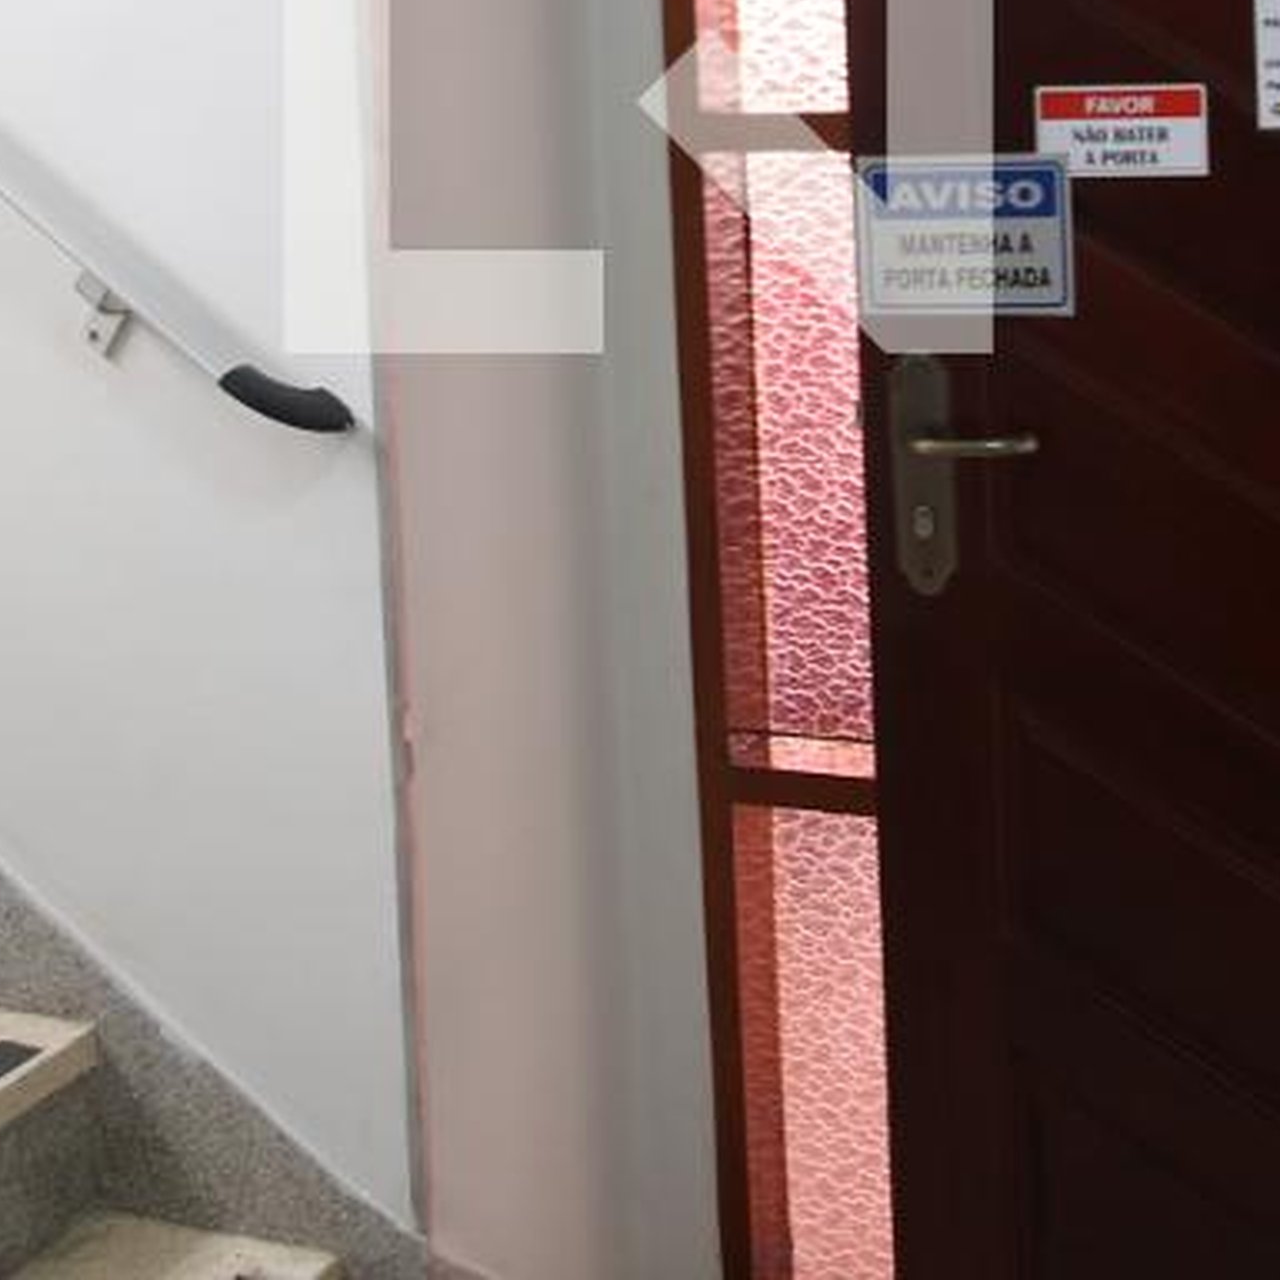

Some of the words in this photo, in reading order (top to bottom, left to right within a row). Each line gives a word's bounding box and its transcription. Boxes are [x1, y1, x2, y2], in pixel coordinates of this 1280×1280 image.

[1084, 95, 1156, 115] FAVOR
[1072, 124, 1107, 144] NÃO
[1111, 126, 1170, 143] BATER
[1101, 149, 1158, 166] PORTA
[888, 178, 1045, 210] AVISO
[901, 231, 1012, 254] MANTENHA
[1018, 231, 1034, 254] A
[884, 266, 952, 290] PORTA
[956, 266, 1052, 289] FECHADA
